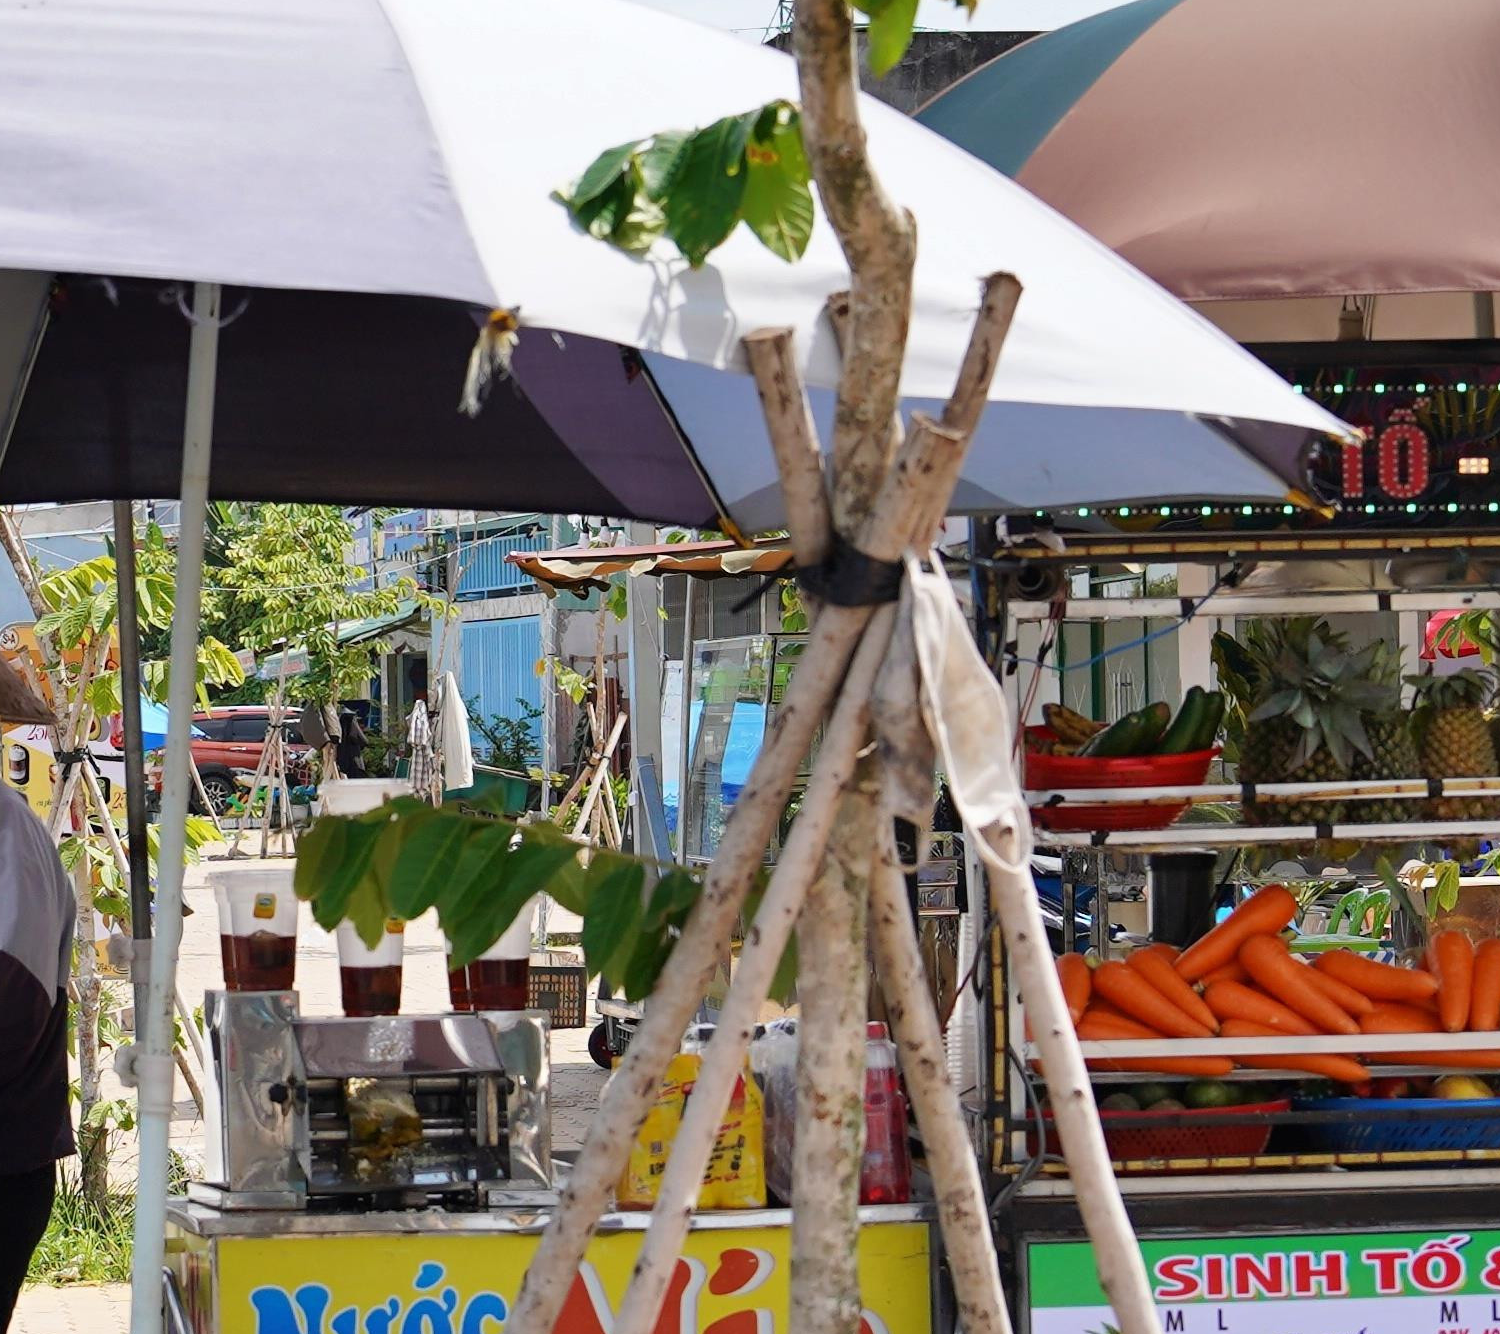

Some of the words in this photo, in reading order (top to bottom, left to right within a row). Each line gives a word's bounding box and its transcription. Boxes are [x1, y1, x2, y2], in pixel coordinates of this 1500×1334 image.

[1155, 1251, 1347, 1299] SINH
[1366, 1234, 1475, 1294] TỐ
[1165, 1310, 1184, 1332] M
[1217, 1309, 1229, 1331] L
[1440, 1301, 1459, 1323] M
